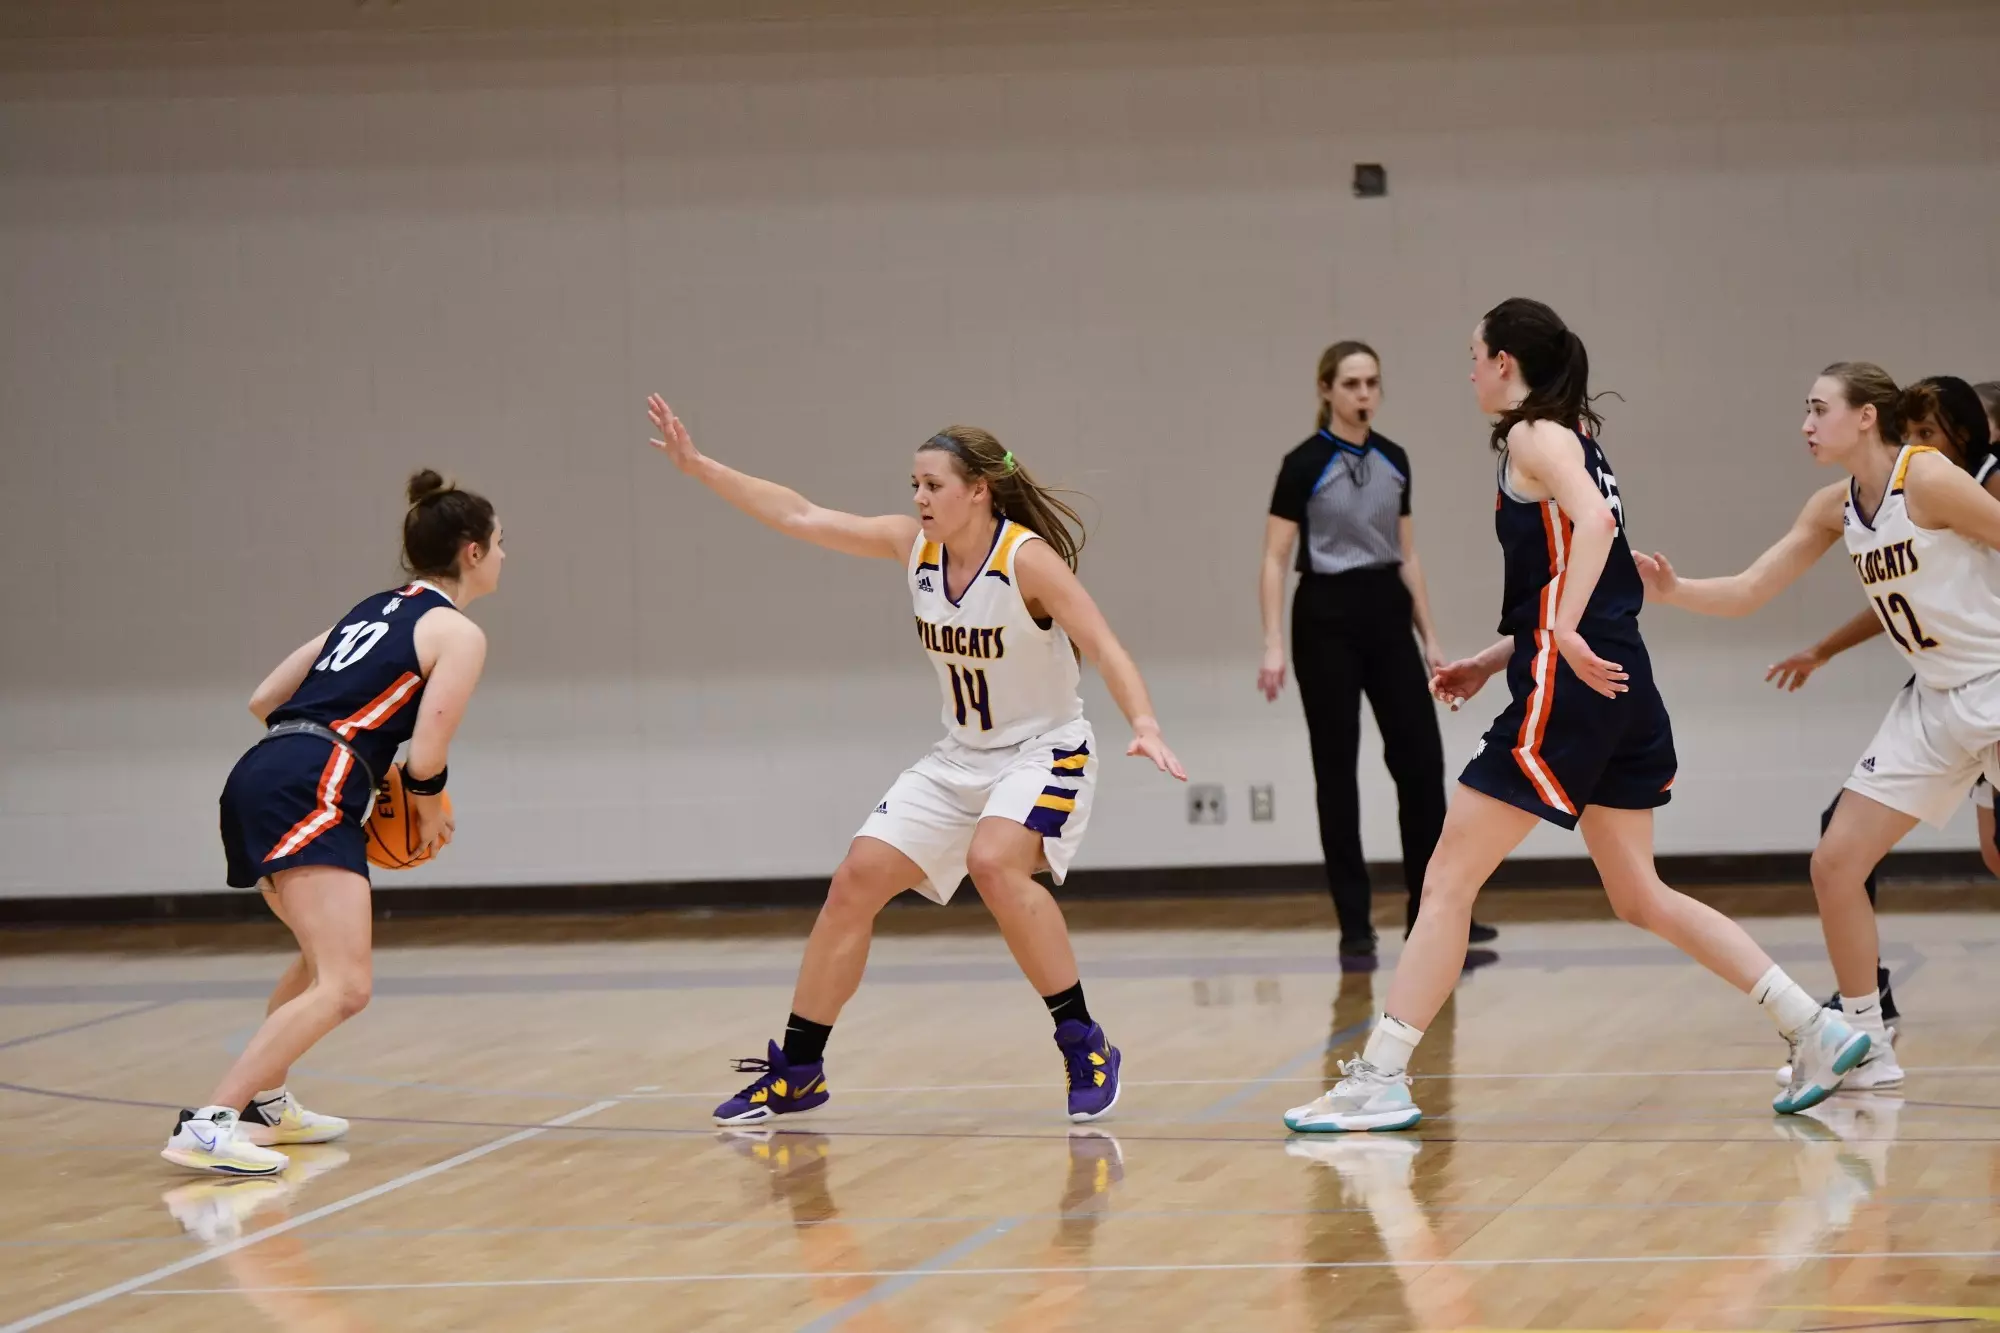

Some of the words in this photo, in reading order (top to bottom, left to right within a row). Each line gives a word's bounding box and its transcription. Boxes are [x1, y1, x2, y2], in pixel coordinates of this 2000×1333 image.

[1597, 466, 1625, 537] 5
[1850, 538, 1919, 585] LDCATS
[315, 620, 389, 672] 10
[1873, 591, 1941, 653] 12
[946, 663, 993, 731] 14
